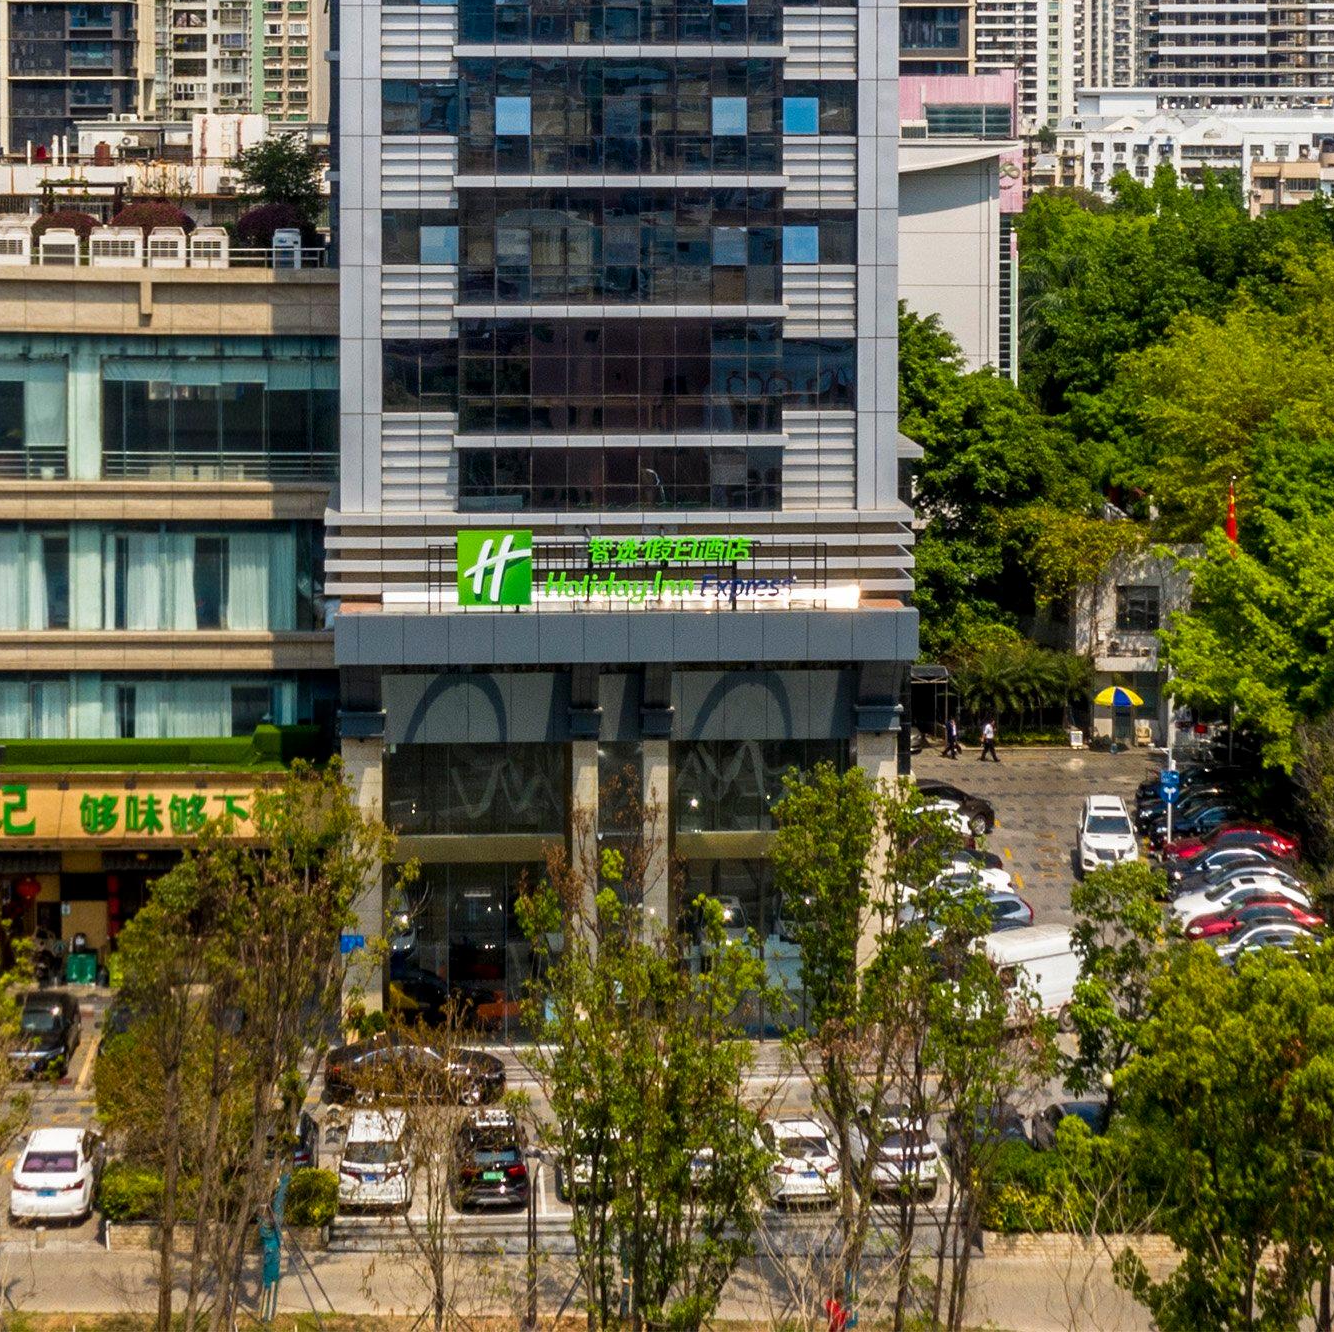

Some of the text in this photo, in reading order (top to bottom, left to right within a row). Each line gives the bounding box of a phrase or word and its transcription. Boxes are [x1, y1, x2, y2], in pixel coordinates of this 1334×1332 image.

[589, 536, 752, 563] 智选假日酒店
[545, 571, 793, 604] Holiday Inn Express
[80, 792, 287, 836] 够味够下
